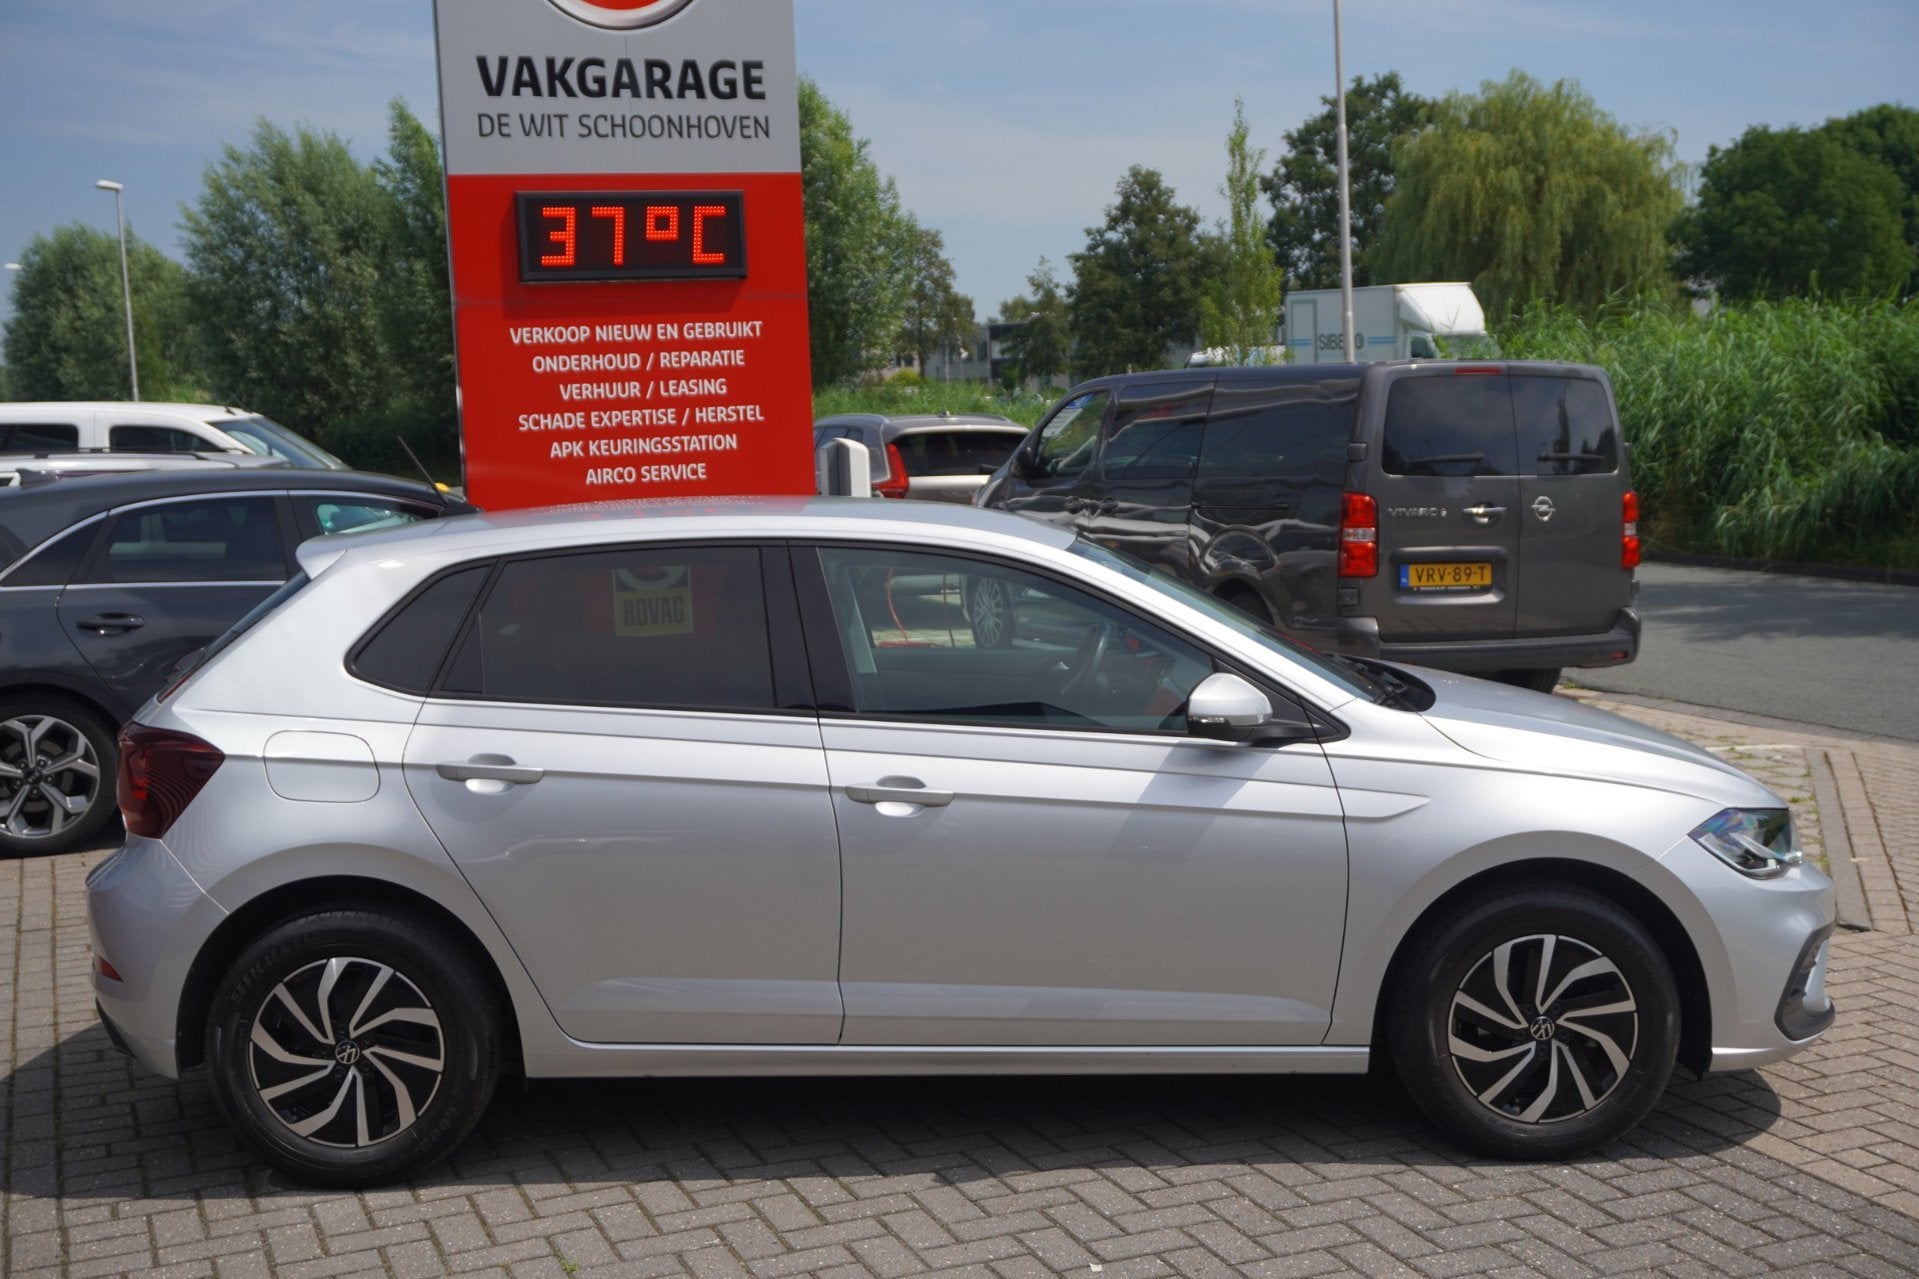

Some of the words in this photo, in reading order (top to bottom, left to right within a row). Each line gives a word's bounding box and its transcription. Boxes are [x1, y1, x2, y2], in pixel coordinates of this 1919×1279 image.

[476, 55, 766, 100] VAKGARAGE
[477, 113, 511, 138] DE
[519, 113, 568, 138] WIT
[578, 113, 770, 139] SCHOONHOVEN
[510, 326, 590, 344] VERKOOP
[595, 323, 651, 342] NIEUW
[657, 323, 678, 339] EN
[683, 320, 762, 339] GEBRUIKT
[532, 353, 640, 373] ONDERHOUD
[660, 350, 745, 368] REPARATIE
[560, 381, 640, 400] VERHUUR
[659, 378, 727, 396] LEASING
[518, 412, 586, 431] SCHADE
[591, 409, 676, 428] EXPERTISE
[695, 405, 764, 422] HERSTEL
[550, 441, 583, 458] APK
[588, 434, 737, 456] KEURINGSSTATION
[586, 467, 636, 485] AIRCO
[641, 463, 707, 481] SERVICE
[1415, 566, 1487, 583] VRV-89-T
[623, 595, 685, 626] BOVAG
